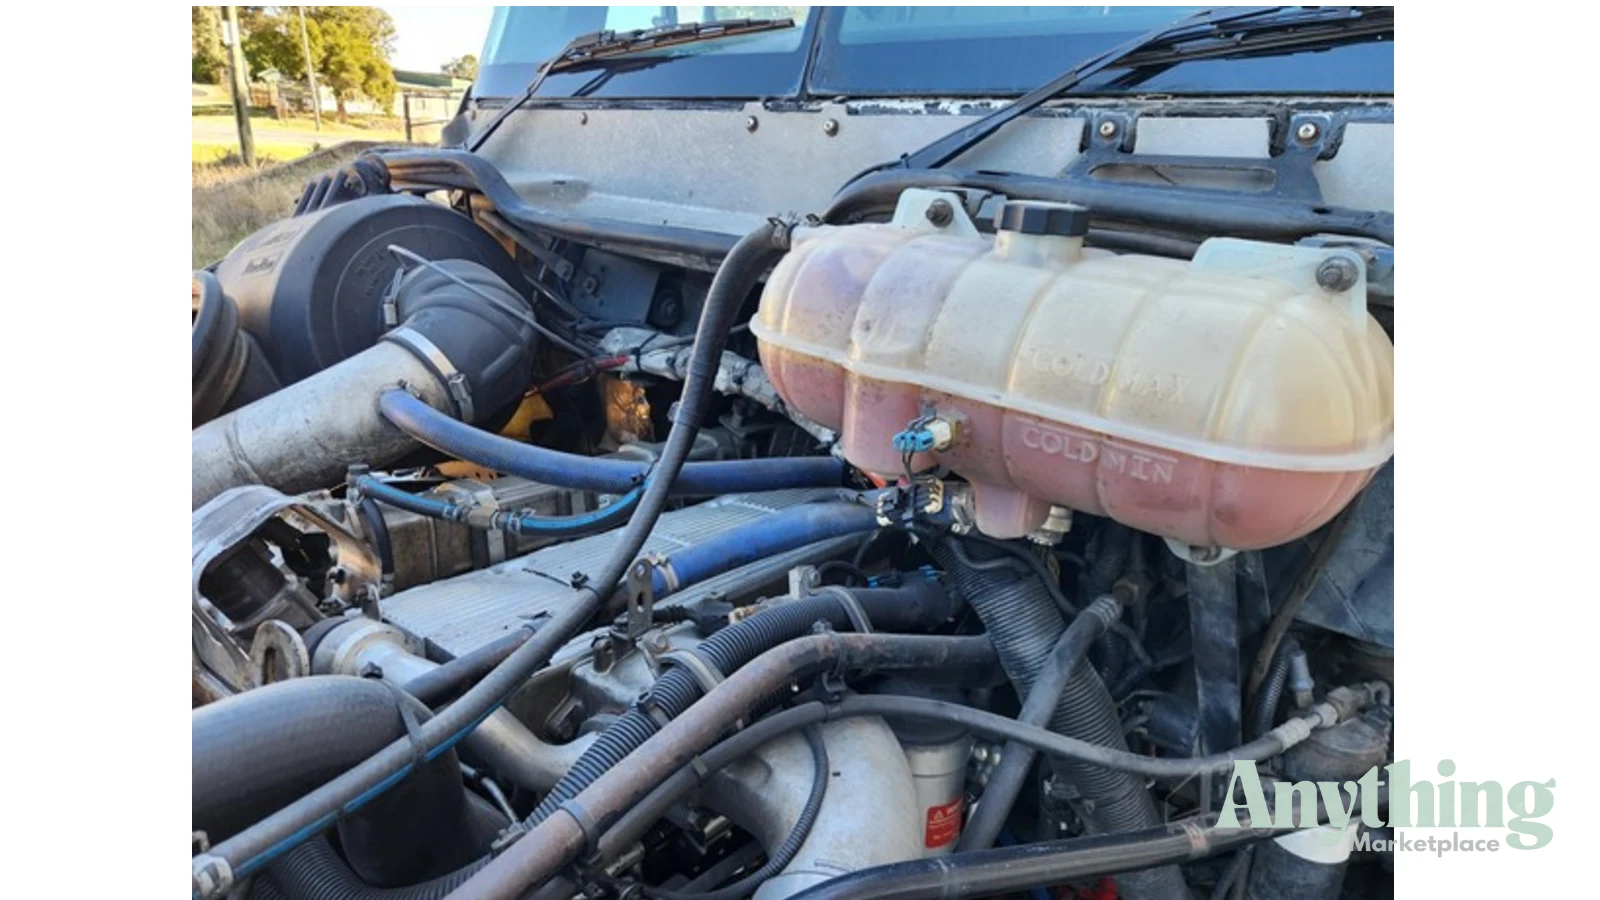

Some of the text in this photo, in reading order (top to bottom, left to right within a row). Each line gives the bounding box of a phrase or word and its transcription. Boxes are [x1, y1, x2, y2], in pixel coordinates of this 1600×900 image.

[1033, 350, 1109, 385] COLD
[1022, 427, 1174, 484] COLD MIN
